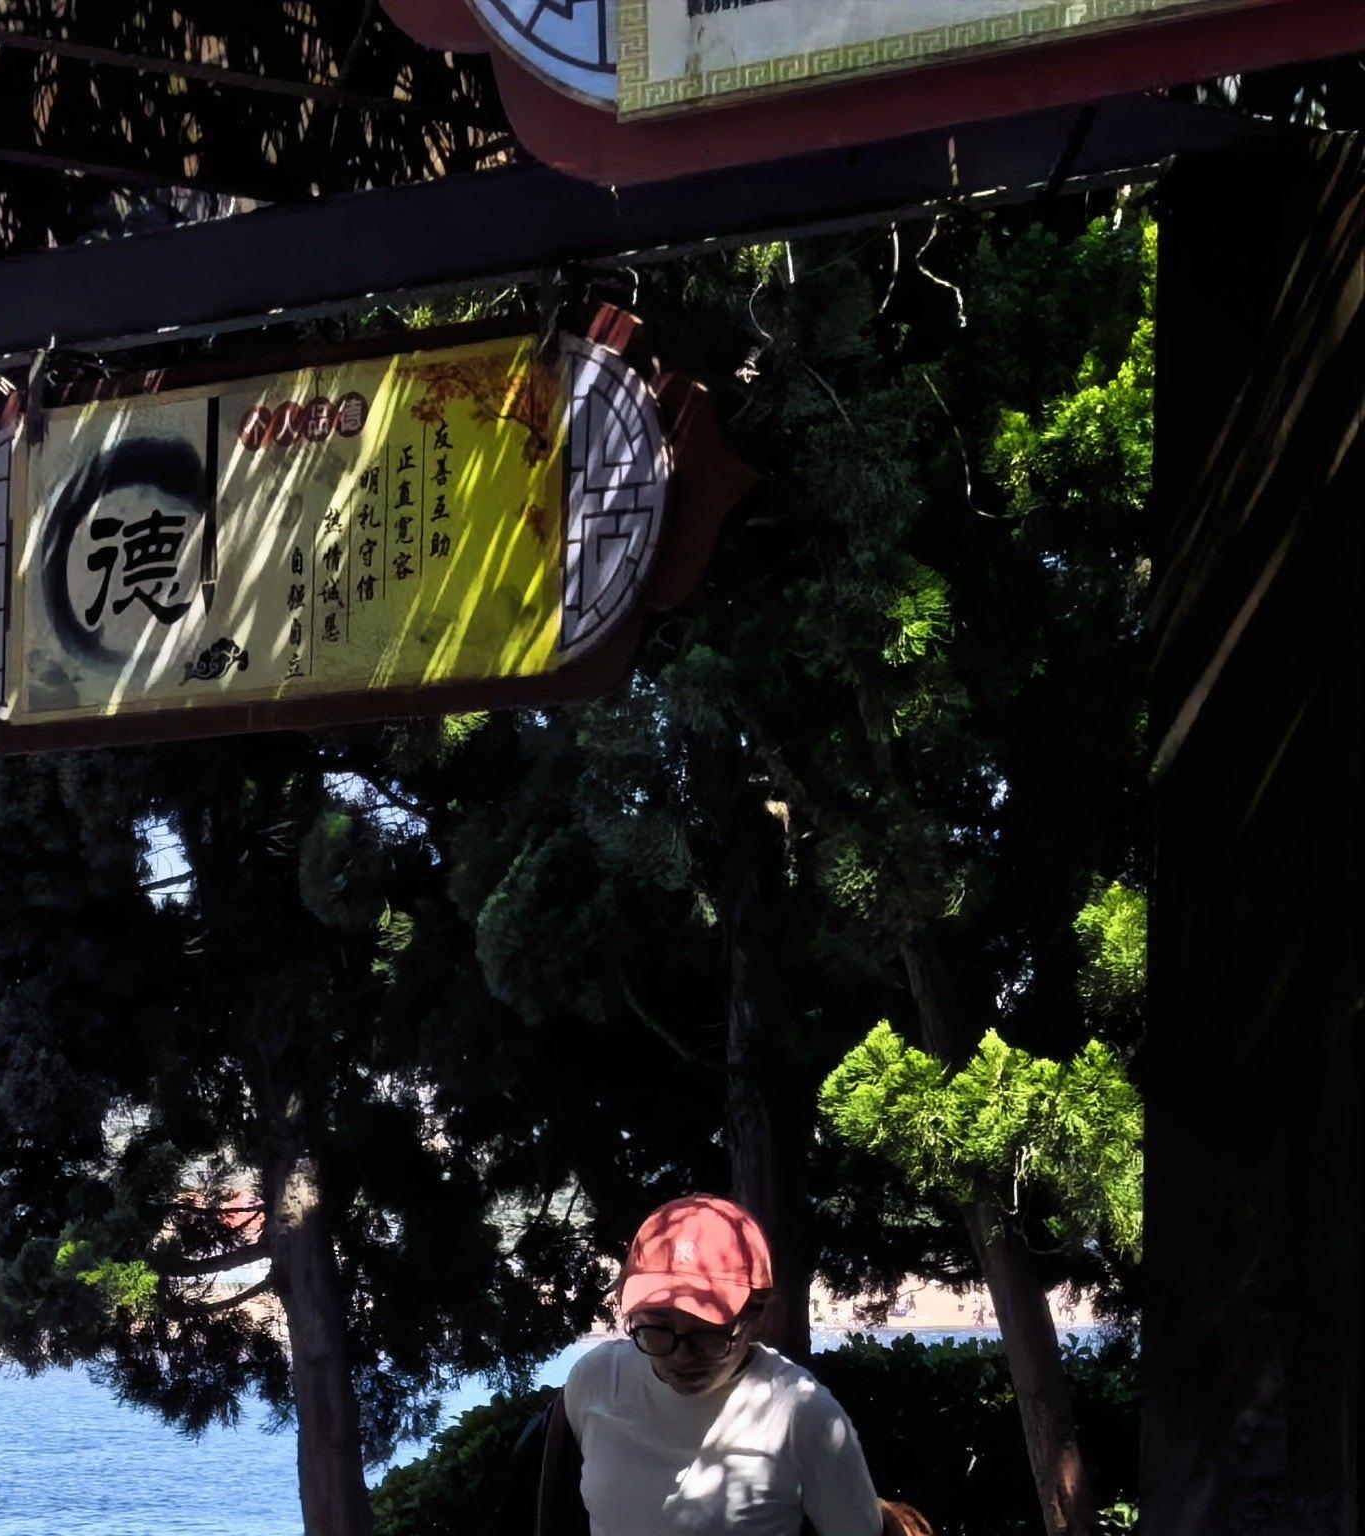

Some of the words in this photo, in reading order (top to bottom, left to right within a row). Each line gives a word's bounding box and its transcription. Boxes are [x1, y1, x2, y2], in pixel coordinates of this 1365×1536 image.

[392, 444, 416, 580] 正直宽容
[430, 419, 454, 559] 友善互助
[85, 509, 192, 626] 德
[284, 546, 306, 679] 自强自立
